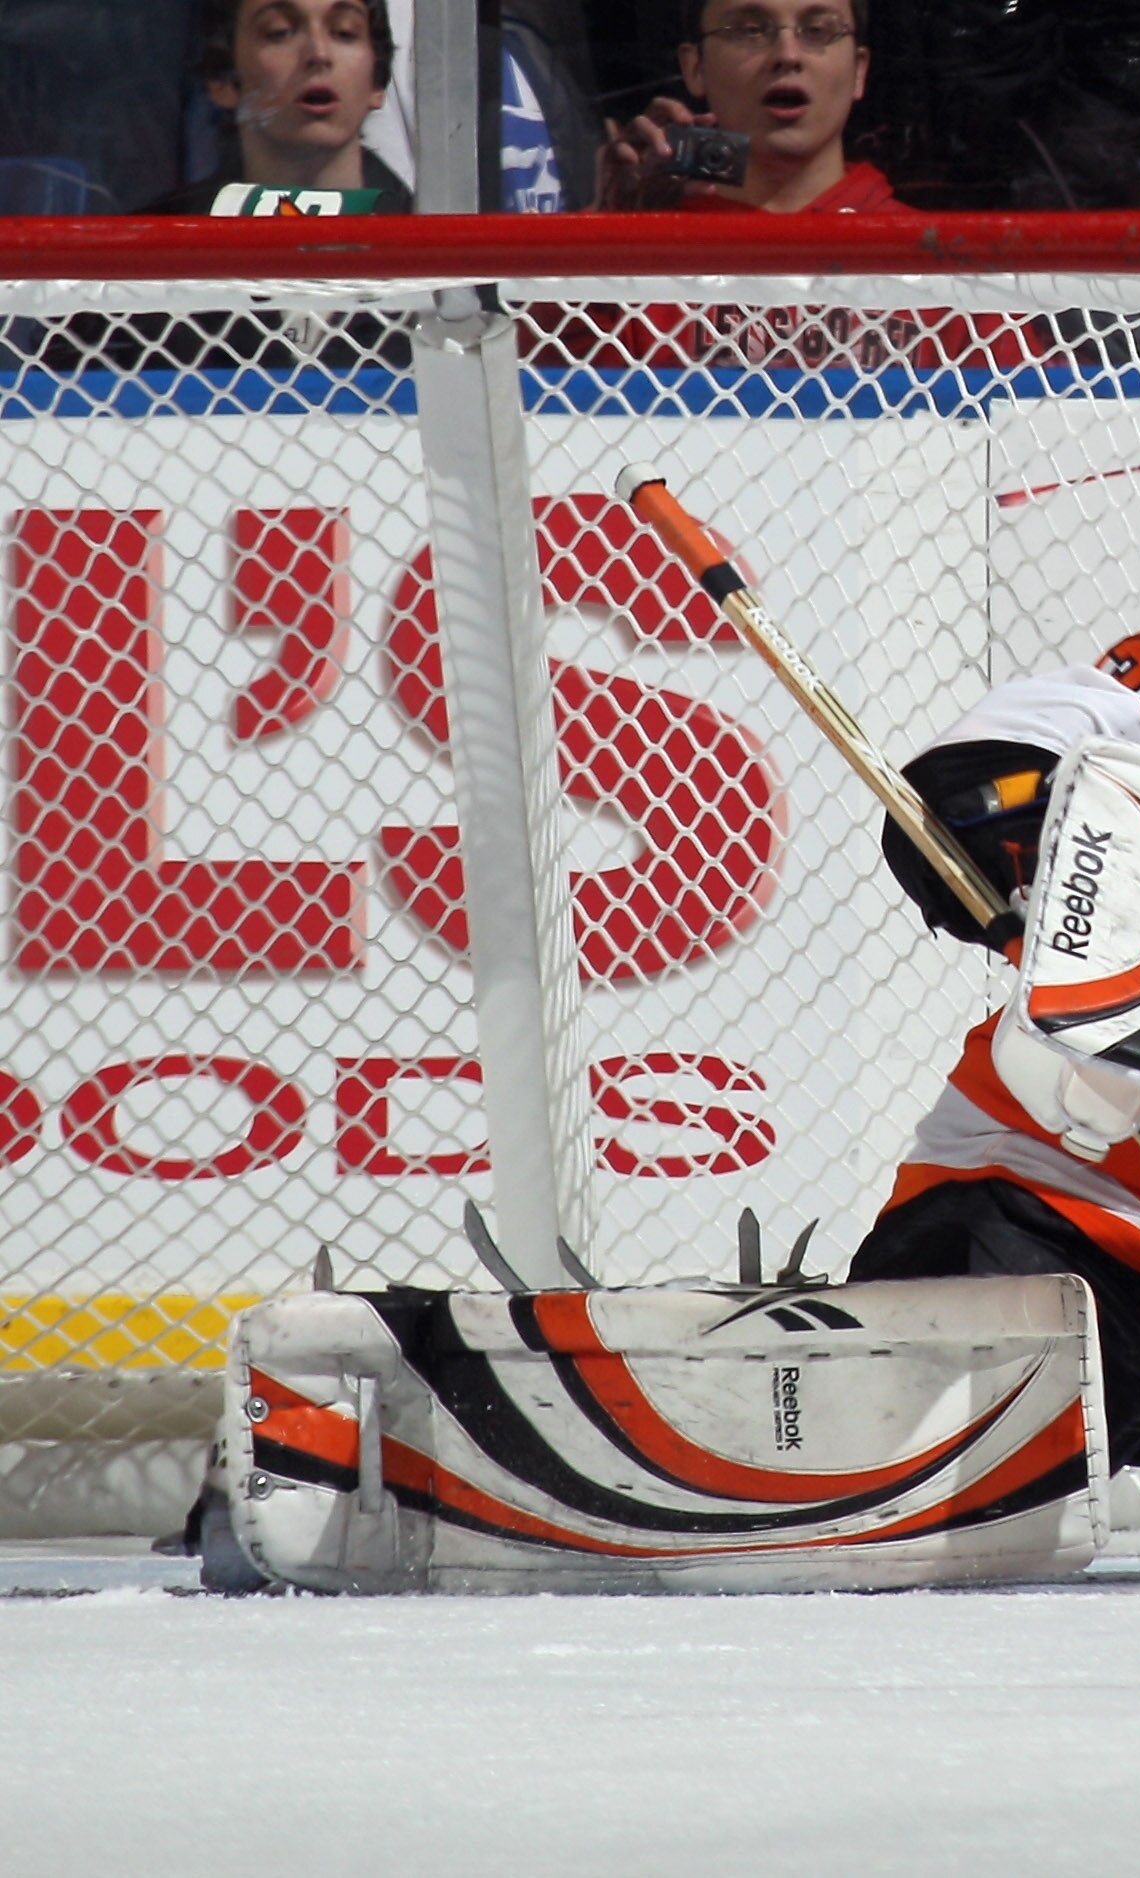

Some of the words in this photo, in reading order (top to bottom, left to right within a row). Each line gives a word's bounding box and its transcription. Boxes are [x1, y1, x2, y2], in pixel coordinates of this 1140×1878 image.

[747, 607, 823, 692] Reebok
[1052, 821, 1112, 961] Reebok
[0, 1050, 778, 1182] ODS
[781, 1366, 804, 1451] Reebok
